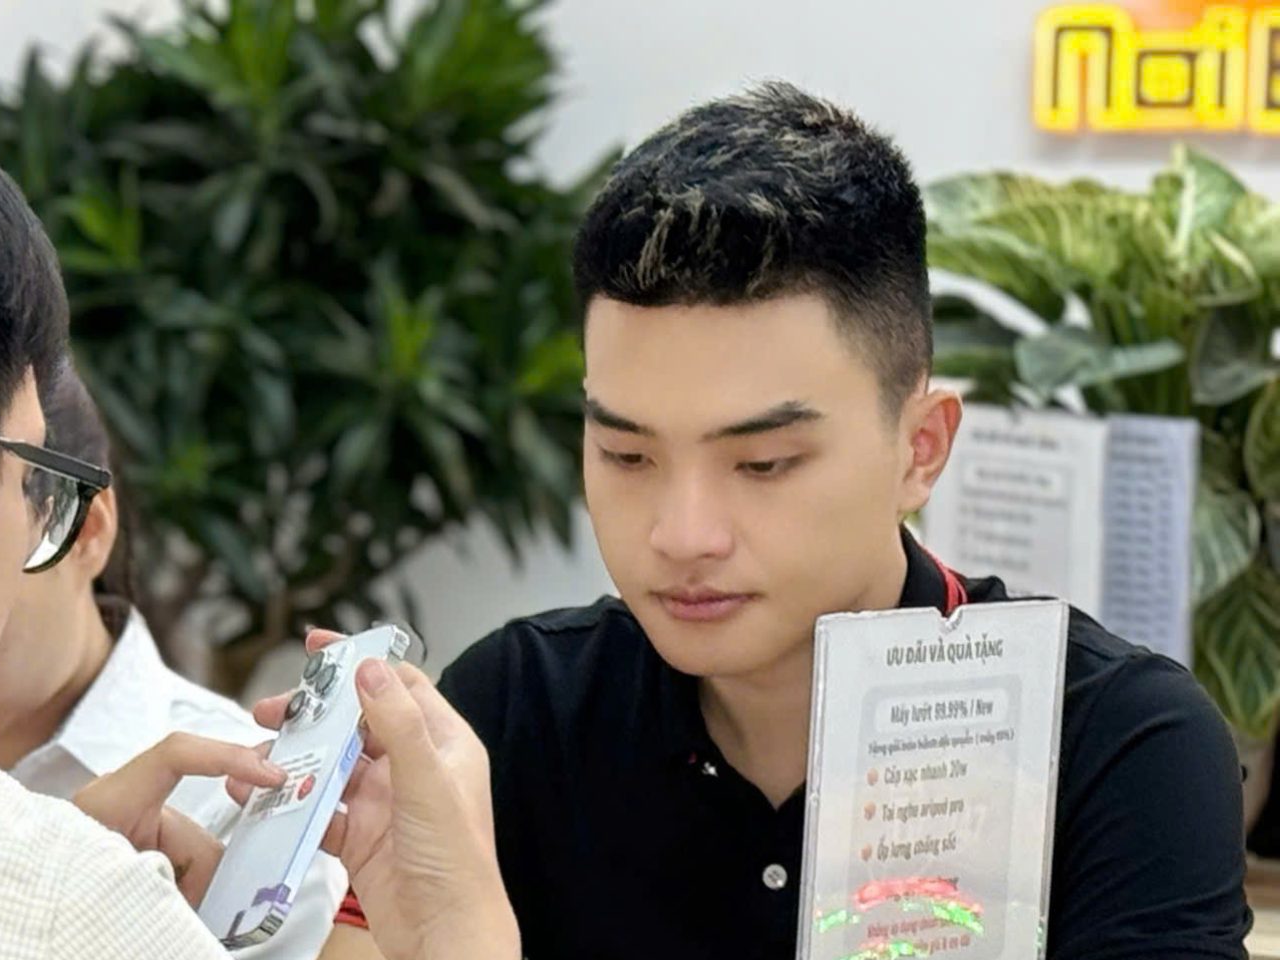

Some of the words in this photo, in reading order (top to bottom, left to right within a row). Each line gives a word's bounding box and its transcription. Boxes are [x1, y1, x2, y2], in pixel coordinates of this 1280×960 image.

[886, 646, 904, 666] ƯU
[906, 640, 927, 664] ĐÃI
[929, 637, 945, 662] VÀ
[947, 634, 973, 664] QUÀ
[974, 632, 1003, 664] TẶNG
[890, 705, 909, 726] Máy
[975, 698, 994, 715] New
[920, 761, 948, 780] nhanh
[882, 803, 894, 822] Tai
[896, 801, 919, 823] nghe
[950, 799, 965, 816] pro
[891, 840, 911, 860] lưng
